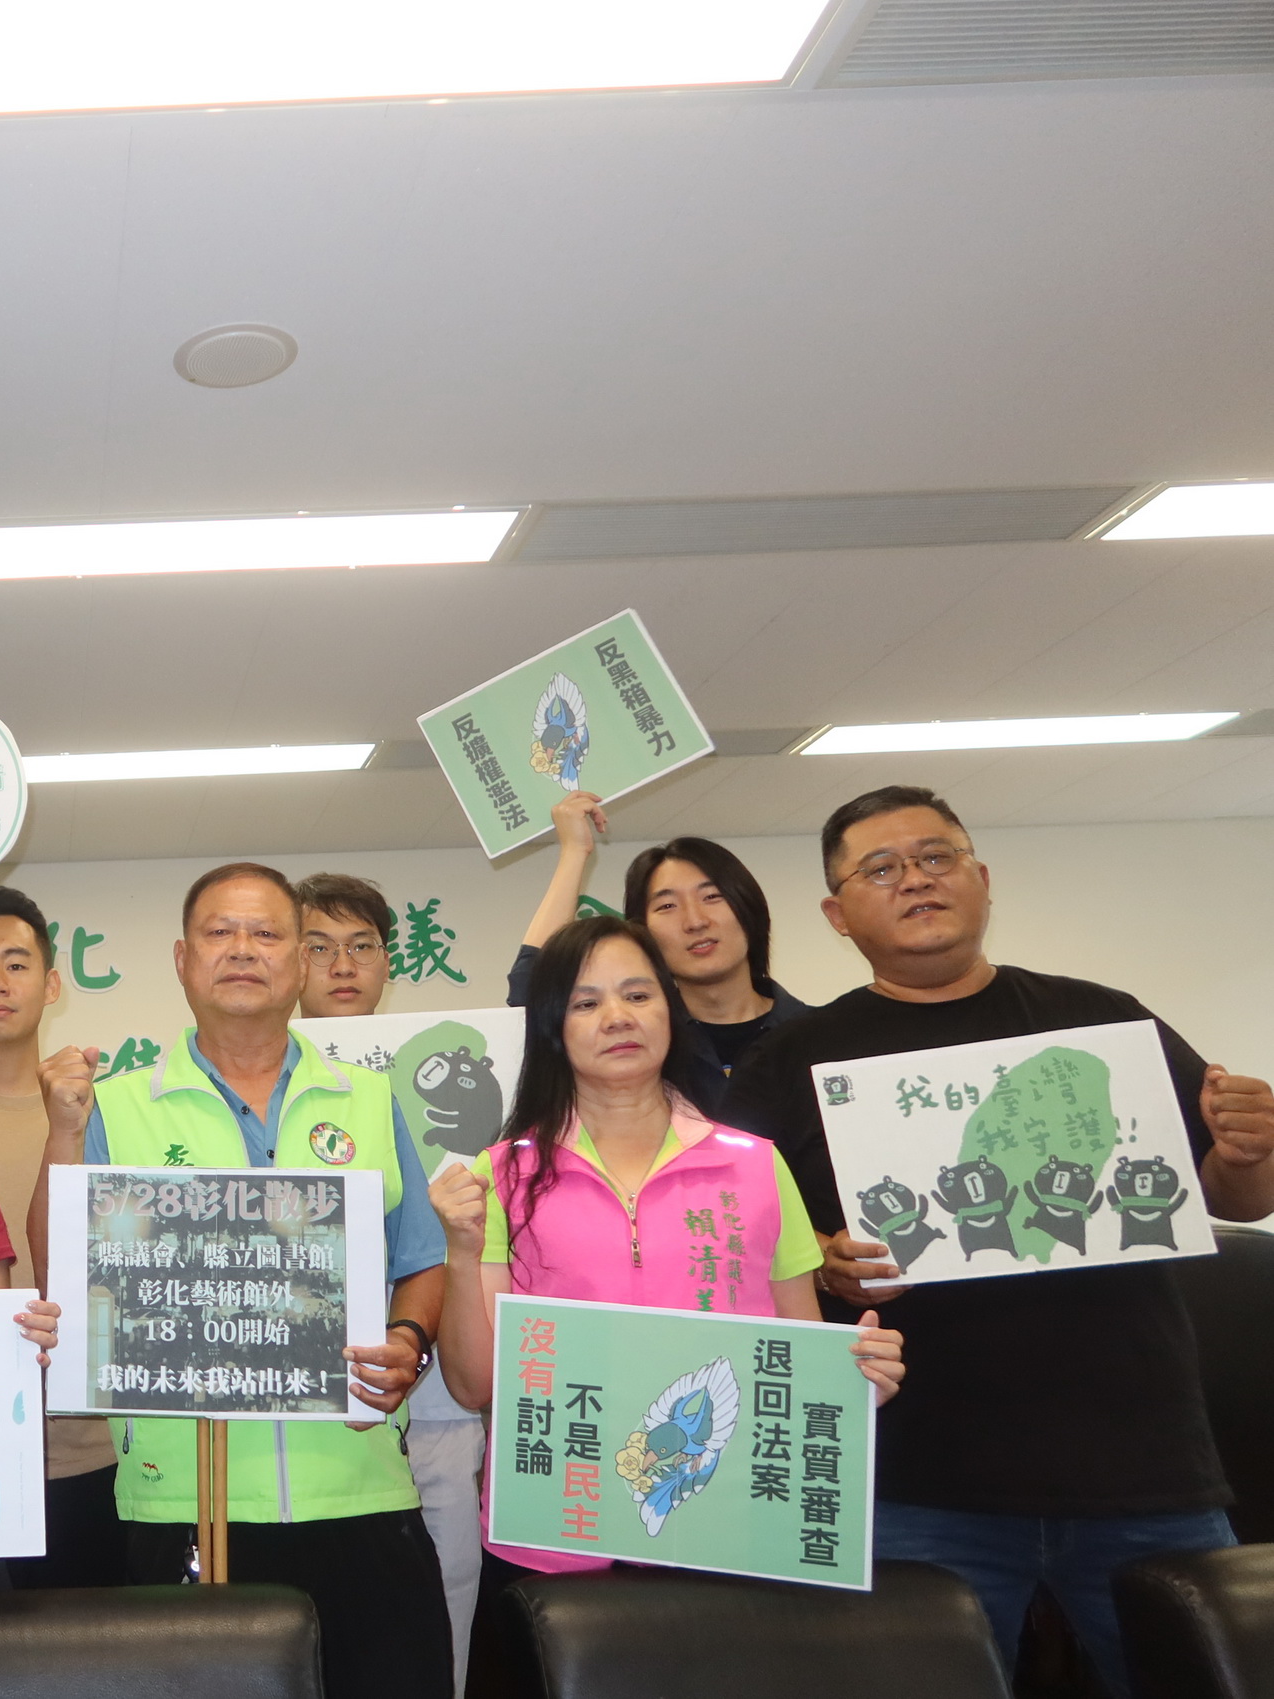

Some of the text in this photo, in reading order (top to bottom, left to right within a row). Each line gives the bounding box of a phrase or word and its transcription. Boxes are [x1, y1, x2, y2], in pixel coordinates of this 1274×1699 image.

[594, 637, 676, 757] 反黑箱暴力
[451, 712, 530, 832] 反擴權濫法
[895, 1056, 1081, 1118] 我的臺灣
[92, 1179, 342, 1222] 5/28彰化散步
[137, 1278, 295, 1308] 彰化藝術館外
[515, 1317, 557, 1477] 沒有討論
[750, 1338, 793, 1502] 退回法案
[560, 1382, 603, 1542] 不是民主
[799, 1401, 843, 1568] 實質審查
